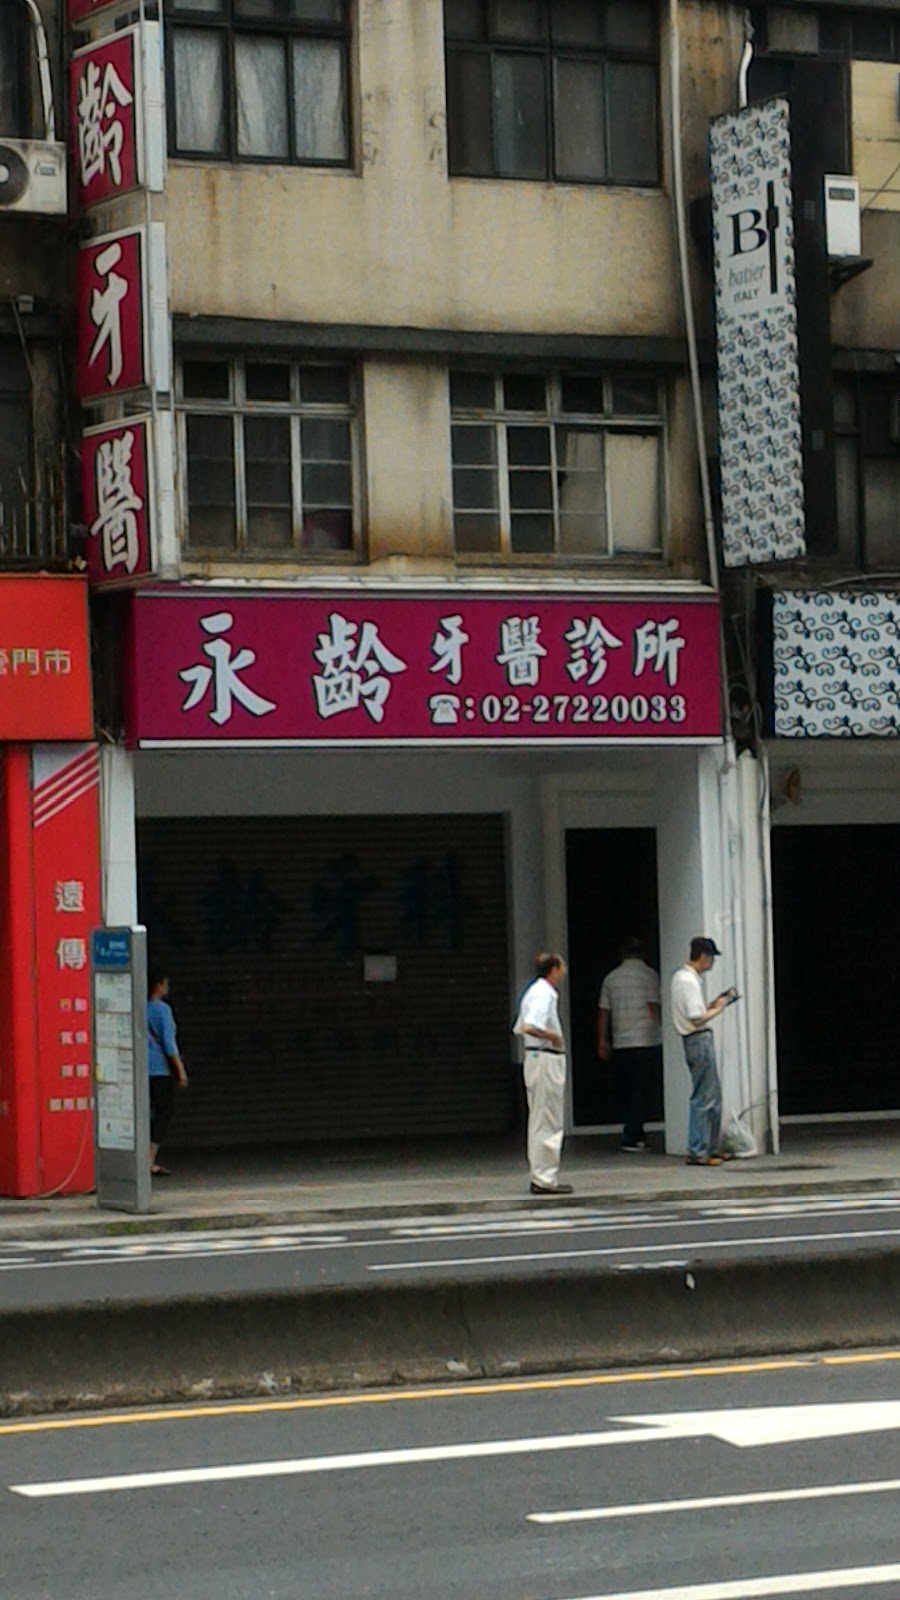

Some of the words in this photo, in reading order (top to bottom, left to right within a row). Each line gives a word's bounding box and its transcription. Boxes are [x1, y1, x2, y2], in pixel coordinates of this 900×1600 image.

[727, 208, 768, 258] B
[78, 0, 142, 574] 齡牙醫
[733, 288, 759, 304] ITALY
[180, 612, 408, 726] 永齡
[429, 614, 687, 688] 牙醫診所
